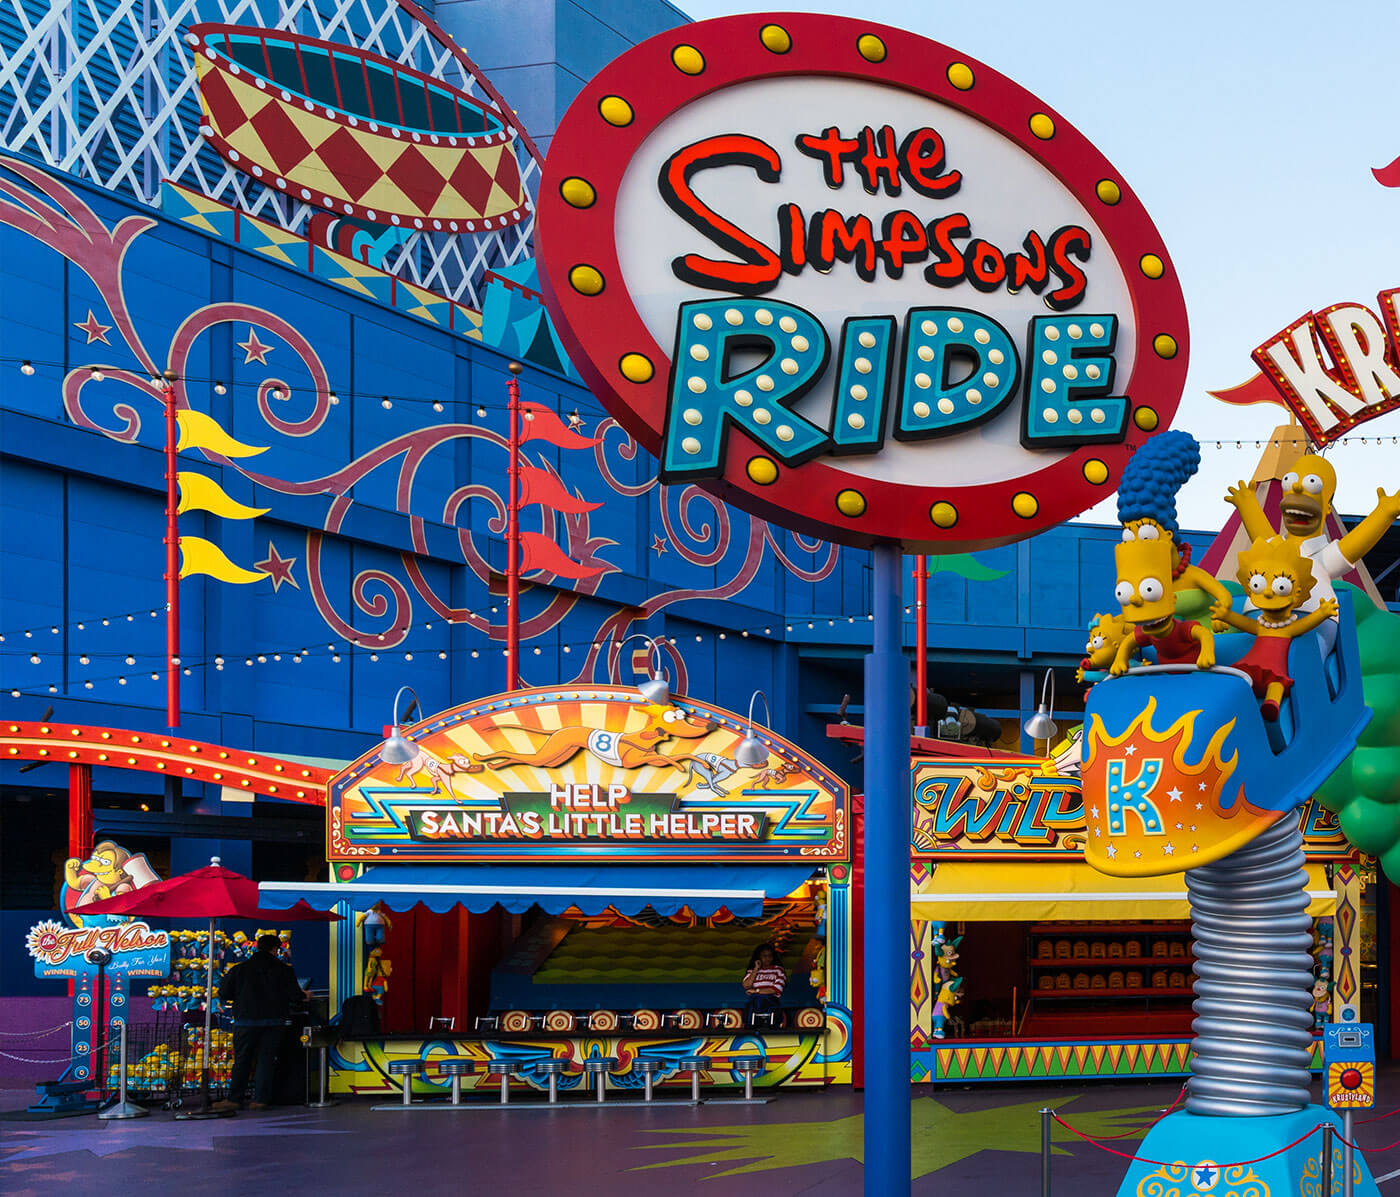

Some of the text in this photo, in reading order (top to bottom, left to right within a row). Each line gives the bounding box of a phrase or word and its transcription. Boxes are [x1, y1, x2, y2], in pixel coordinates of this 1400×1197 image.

[658, 133, 1091, 309] SIMPSONS
[658, 296, 1132, 485] RIDE
[595, 734, 611, 752] 8
[710, 755, 717, 763] 9
[550, 783, 633, 810] HELP
[1105, 758, 1167, 836] K
[420, 811, 758, 838] SANTA'S LITTLE HELPER
[50, 928, 99, 962] Full
[100, 924, 168, 951] Nelson
[127, 969, 163, 977] WINNER!
[1332, 1092, 1371, 1104] KRUSTYLAND
